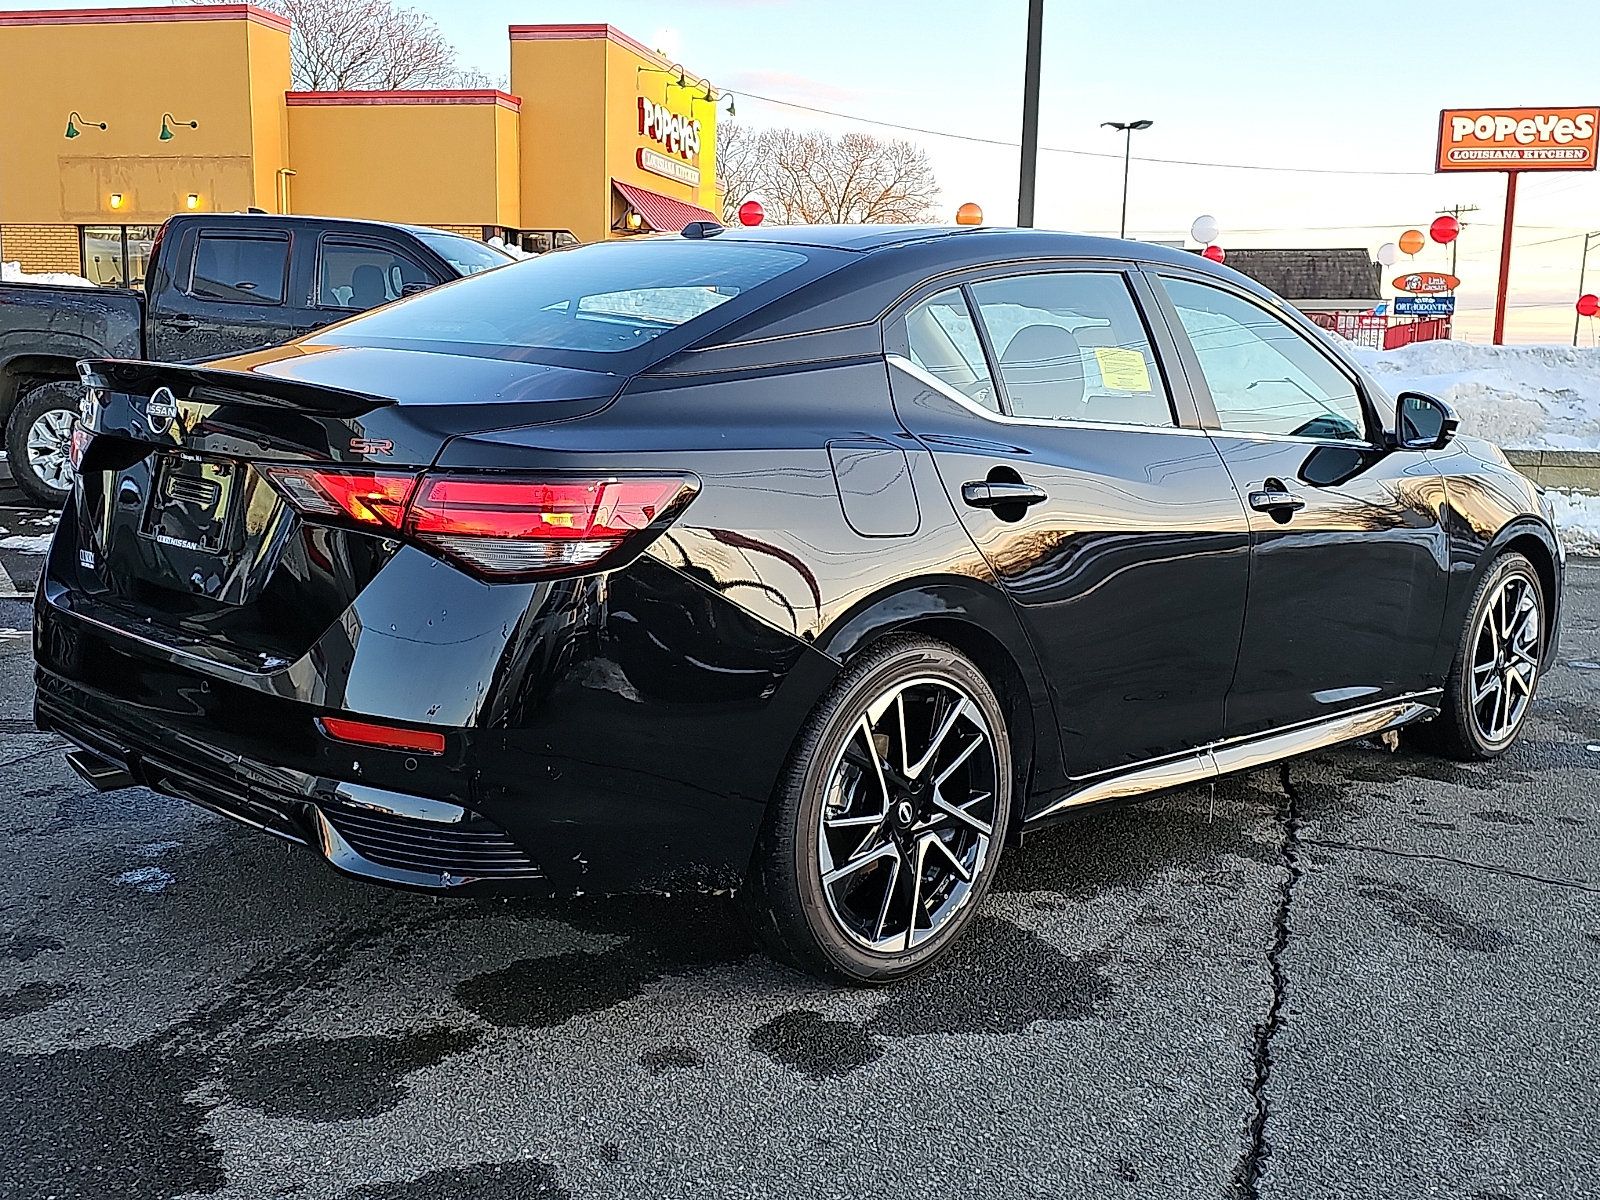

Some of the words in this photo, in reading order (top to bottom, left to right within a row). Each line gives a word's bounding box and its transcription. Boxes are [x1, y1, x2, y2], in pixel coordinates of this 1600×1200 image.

[1453, 150, 1521, 160] LOUISIANA
[1523, 150, 1584, 159] KITCHEN
[147, 402, 177, 418] ISSAN
[350, 438, 394, 456] SR
